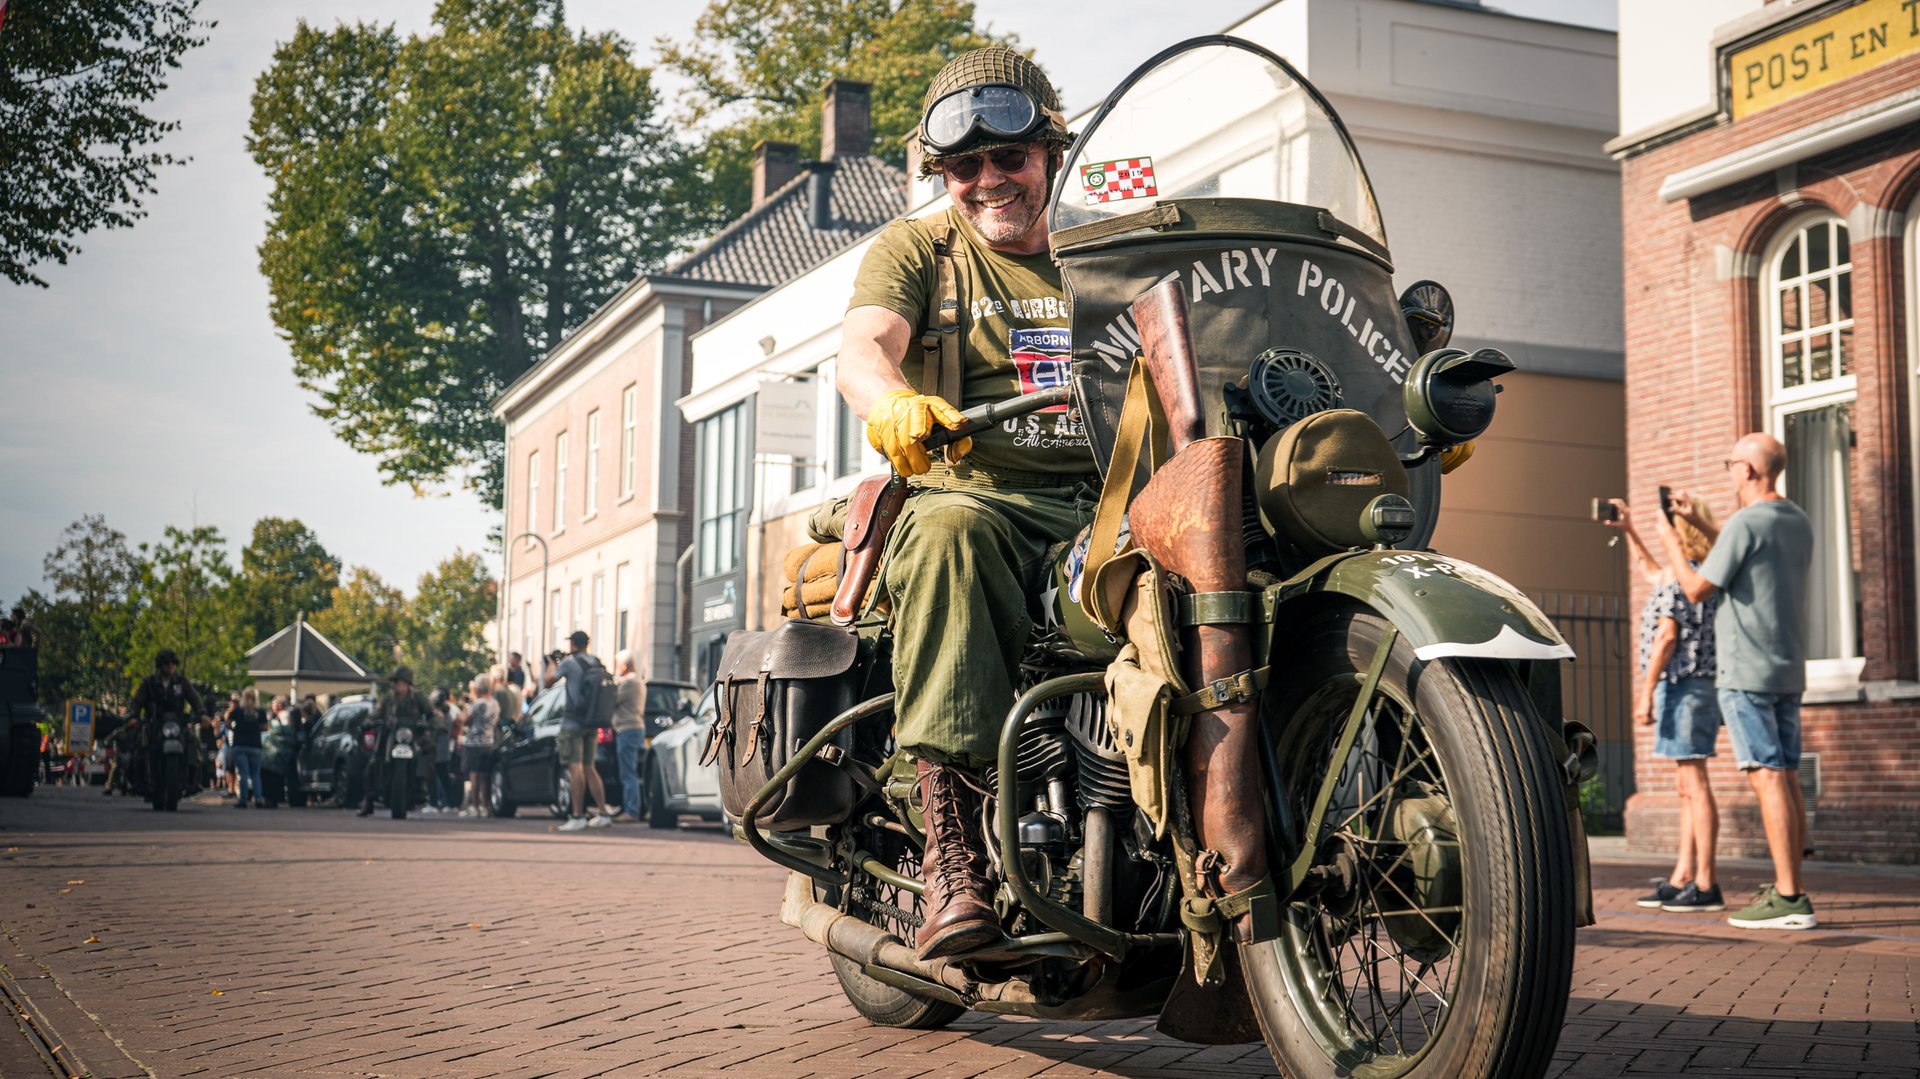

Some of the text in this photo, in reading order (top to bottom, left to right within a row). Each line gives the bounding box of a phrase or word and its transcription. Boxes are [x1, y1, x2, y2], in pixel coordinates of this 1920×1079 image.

[1745, 31, 1834, 99] POST
[1851, 23, 1888, 59] EN
[1010, 296, 1068, 319] AIRBO
[1090, 247, 1413, 385] MIARY POLICE
[1003, 414, 1046, 436] U.S.
[1013, 434, 1040, 447] All
[75, 704, 87, 721] P
